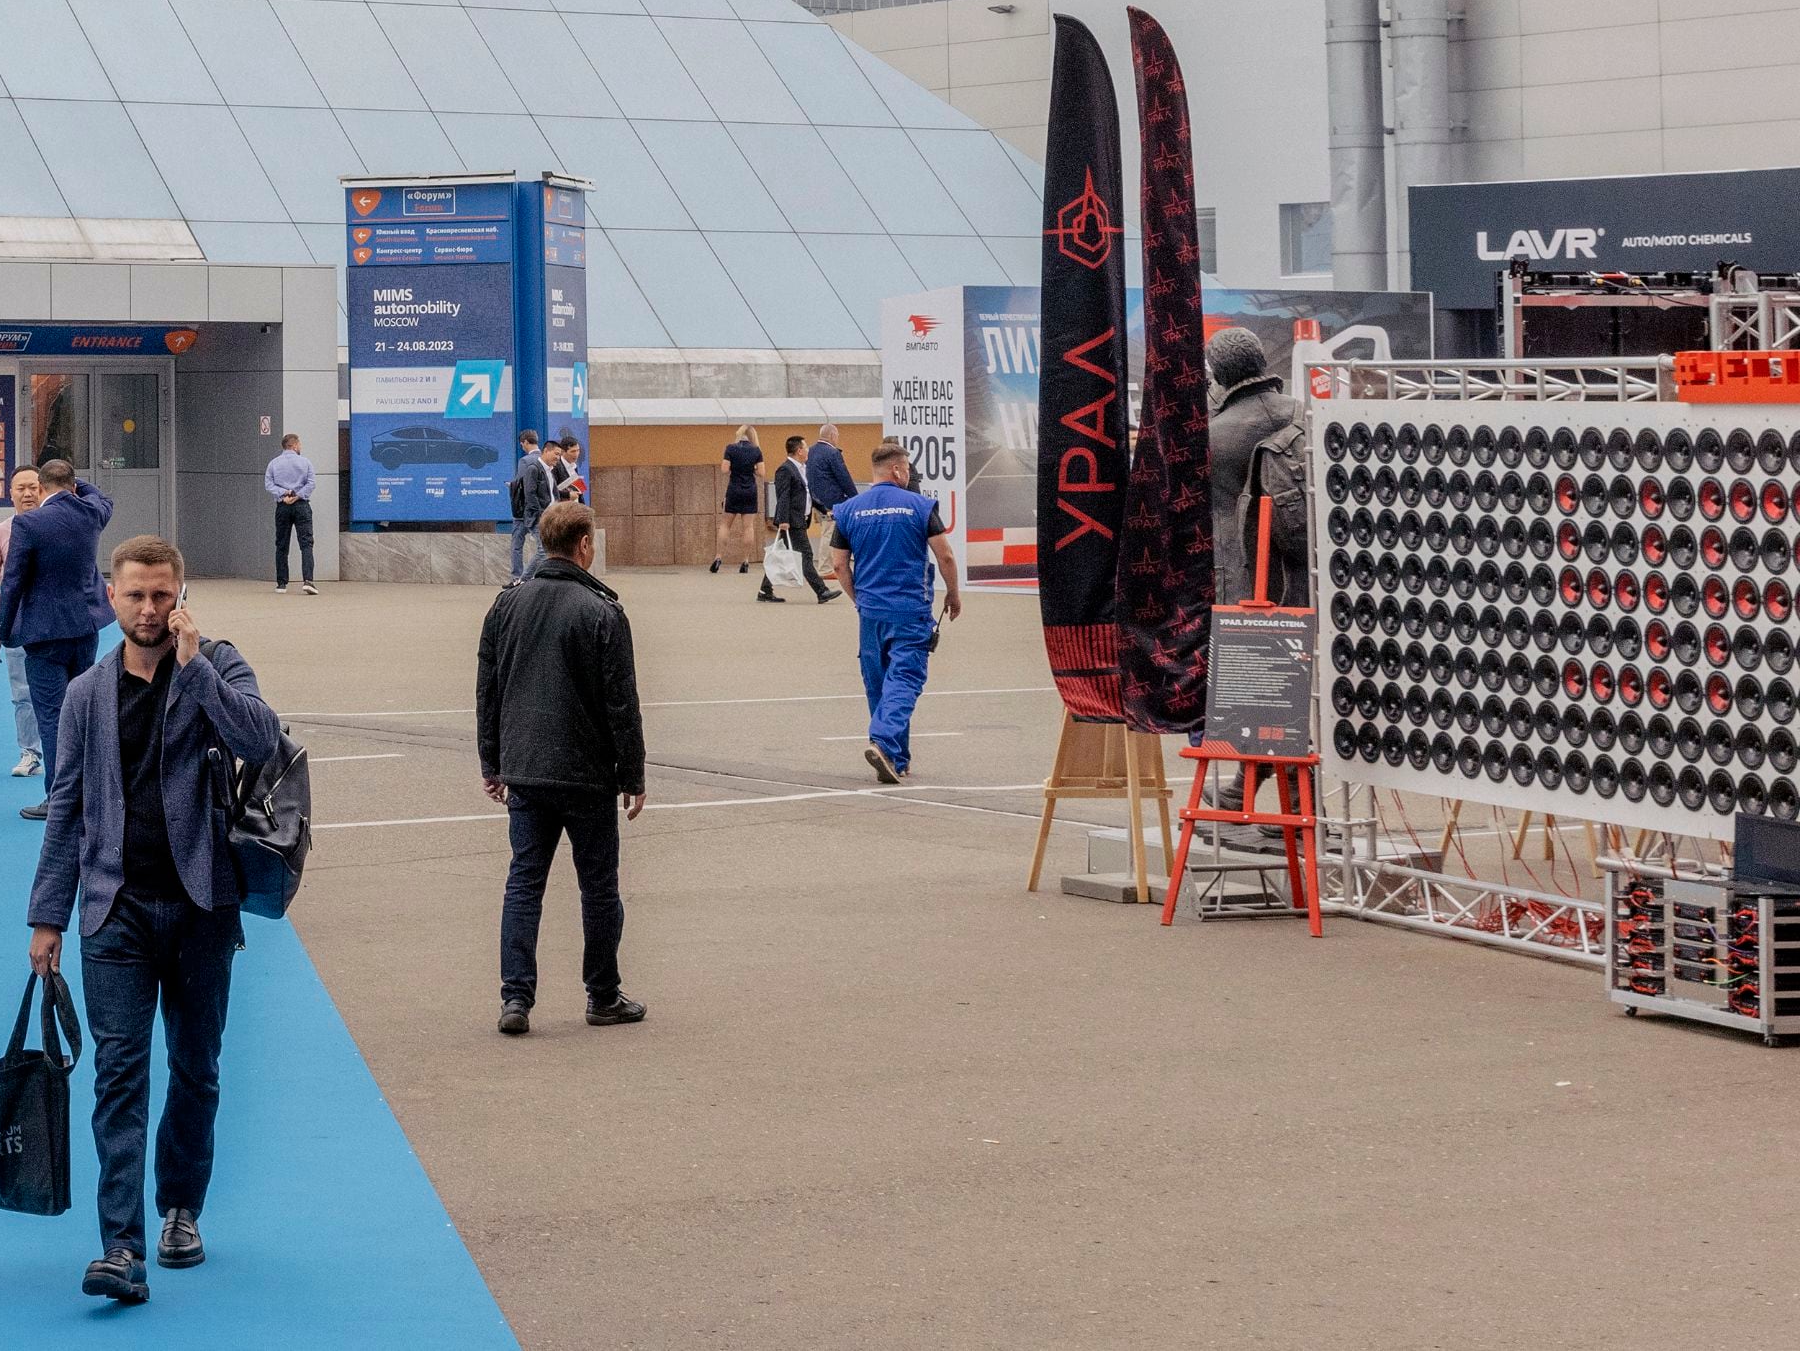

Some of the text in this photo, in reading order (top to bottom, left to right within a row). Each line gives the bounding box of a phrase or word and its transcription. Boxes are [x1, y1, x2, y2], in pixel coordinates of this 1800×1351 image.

[407, 190, 452, 203] «Форум»
[1476, 227, 1752, 261] LAVR AUTO/MOTO CHEMICALS
[373, 288, 413, 301] MIMS
[374, 300, 461, 317] automobility
[374, 317, 419, 328] MOSCOW
[72, 335, 143, 348] ENTRANCE
[375, 341, 386, 352] 21
[397, 341, 454, 352] 24.08.2023
[906, 342, 939, 351] ВМПАВТО
[981, 326, 1041, 374] ЛИ
[892, 376, 953, 403] ЖДЁМ ВАС
[893, 406, 955, 428] НА СТЕНДЕ
[1055, 326, 1116, 552] УРАЛ
[860, 507, 914, 518] EXPOCENTRE
[1243, 619, 1279, 627] РУССКАЯ
[1280, 620, 1308, 629] СТЕНА.
